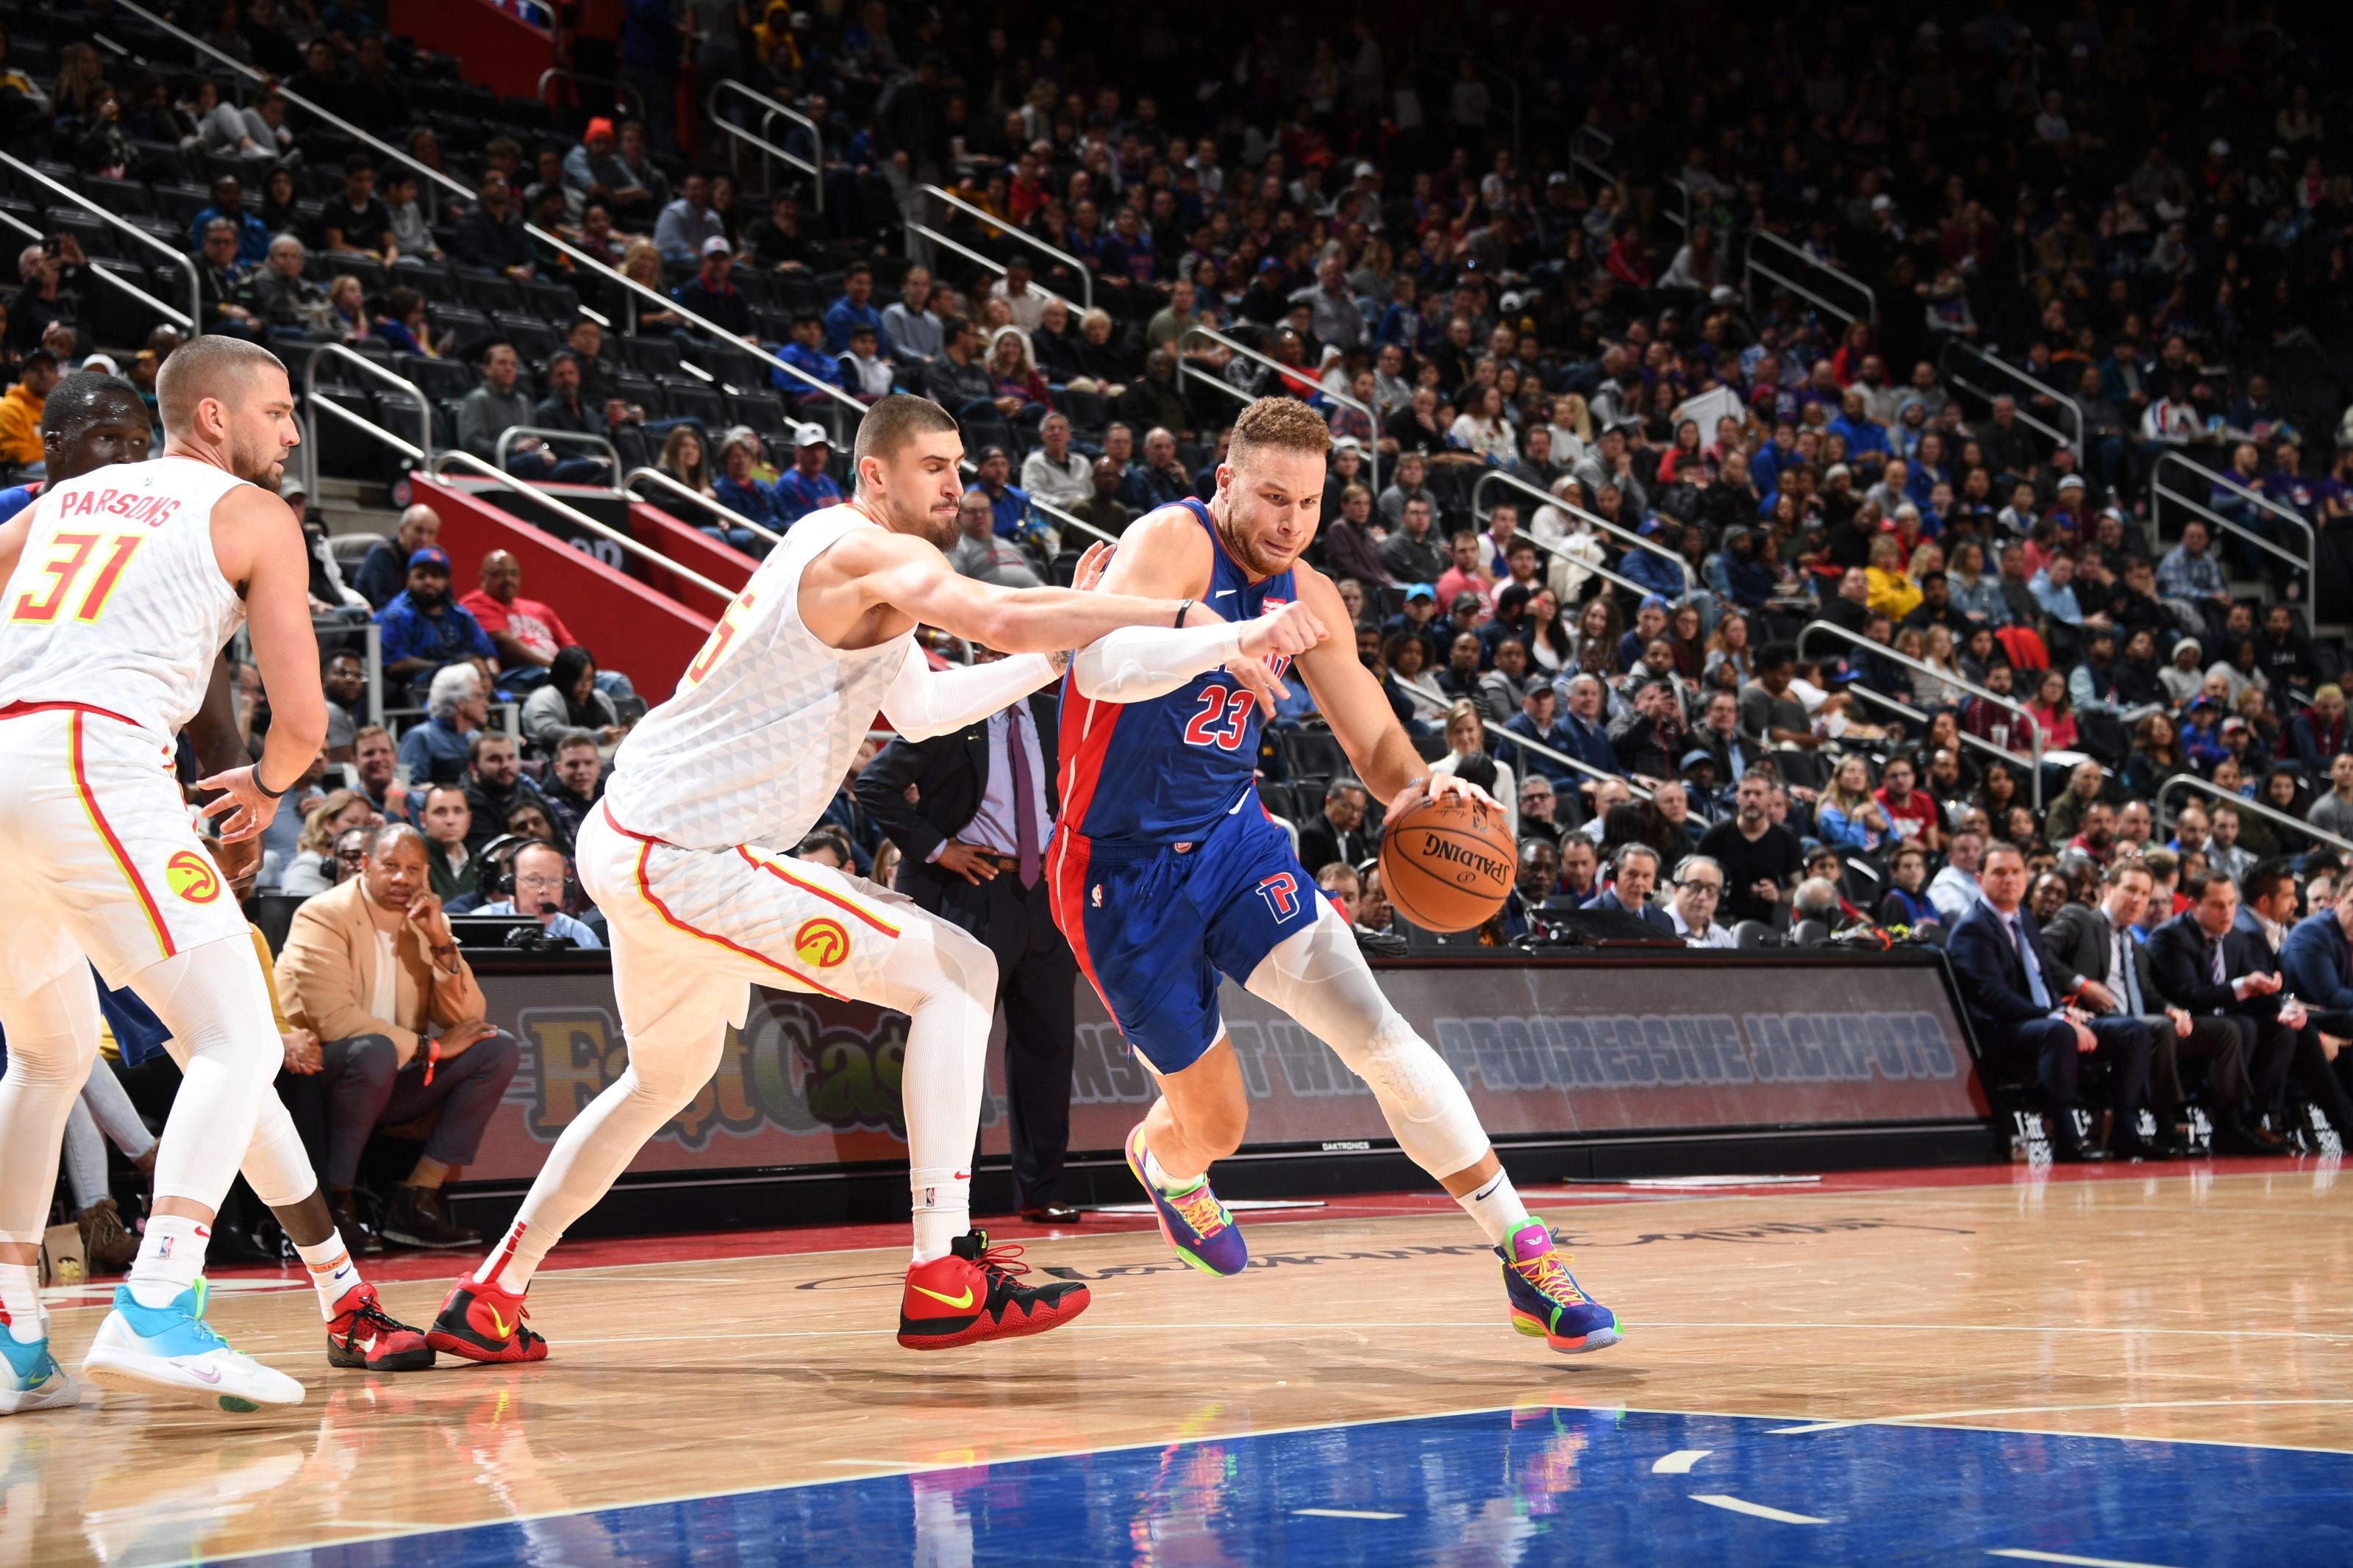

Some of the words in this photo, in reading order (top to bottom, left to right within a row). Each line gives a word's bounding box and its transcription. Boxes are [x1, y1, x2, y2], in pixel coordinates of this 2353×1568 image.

[60, 488, 181, 528] PARSONS
[9, 530, 147, 625] 31
[1184, 684, 1256, 751] 23
[1423, 833, 1510, 887] SPALDING
[1433, 1015, 1753, 1091] PROGRESSIVE
[1742, 1011, 1957, 1083] JACKPOTS
